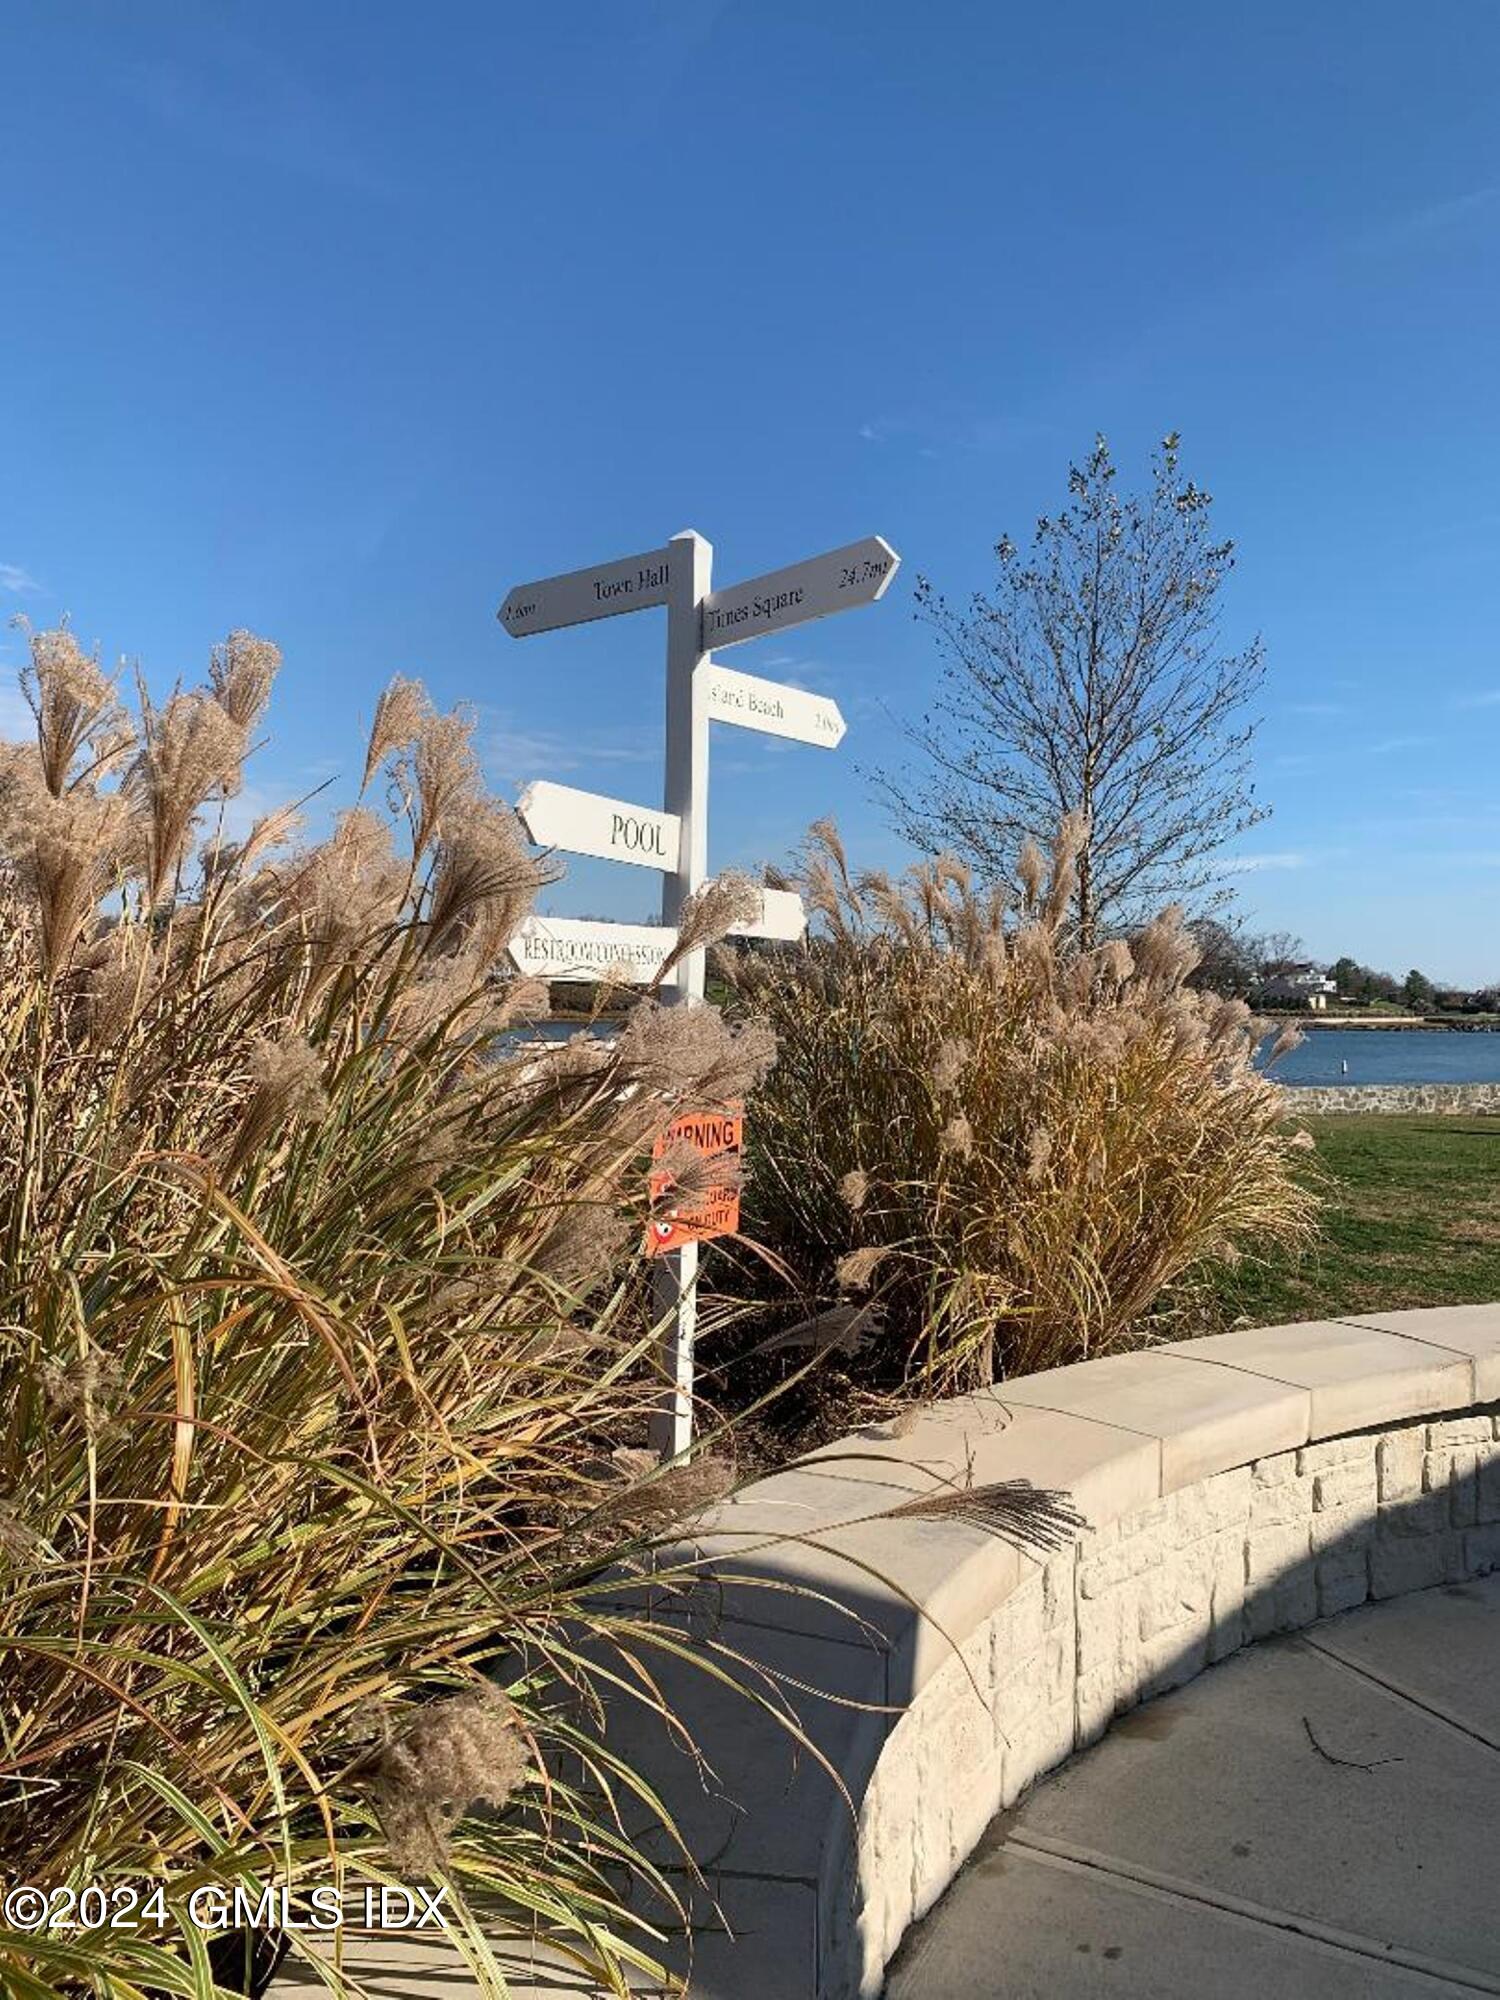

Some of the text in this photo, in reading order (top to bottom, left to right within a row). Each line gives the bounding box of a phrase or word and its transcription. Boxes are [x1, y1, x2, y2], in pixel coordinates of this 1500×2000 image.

[593, 578, 633, 601] Town
[638, 563, 669, 591] Hall
[706, 605, 749, 632] Times
[752, 586, 804, 619] Square
[707, 683, 784, 719] sland Beach
[611, 813, 667, 857] POOL
